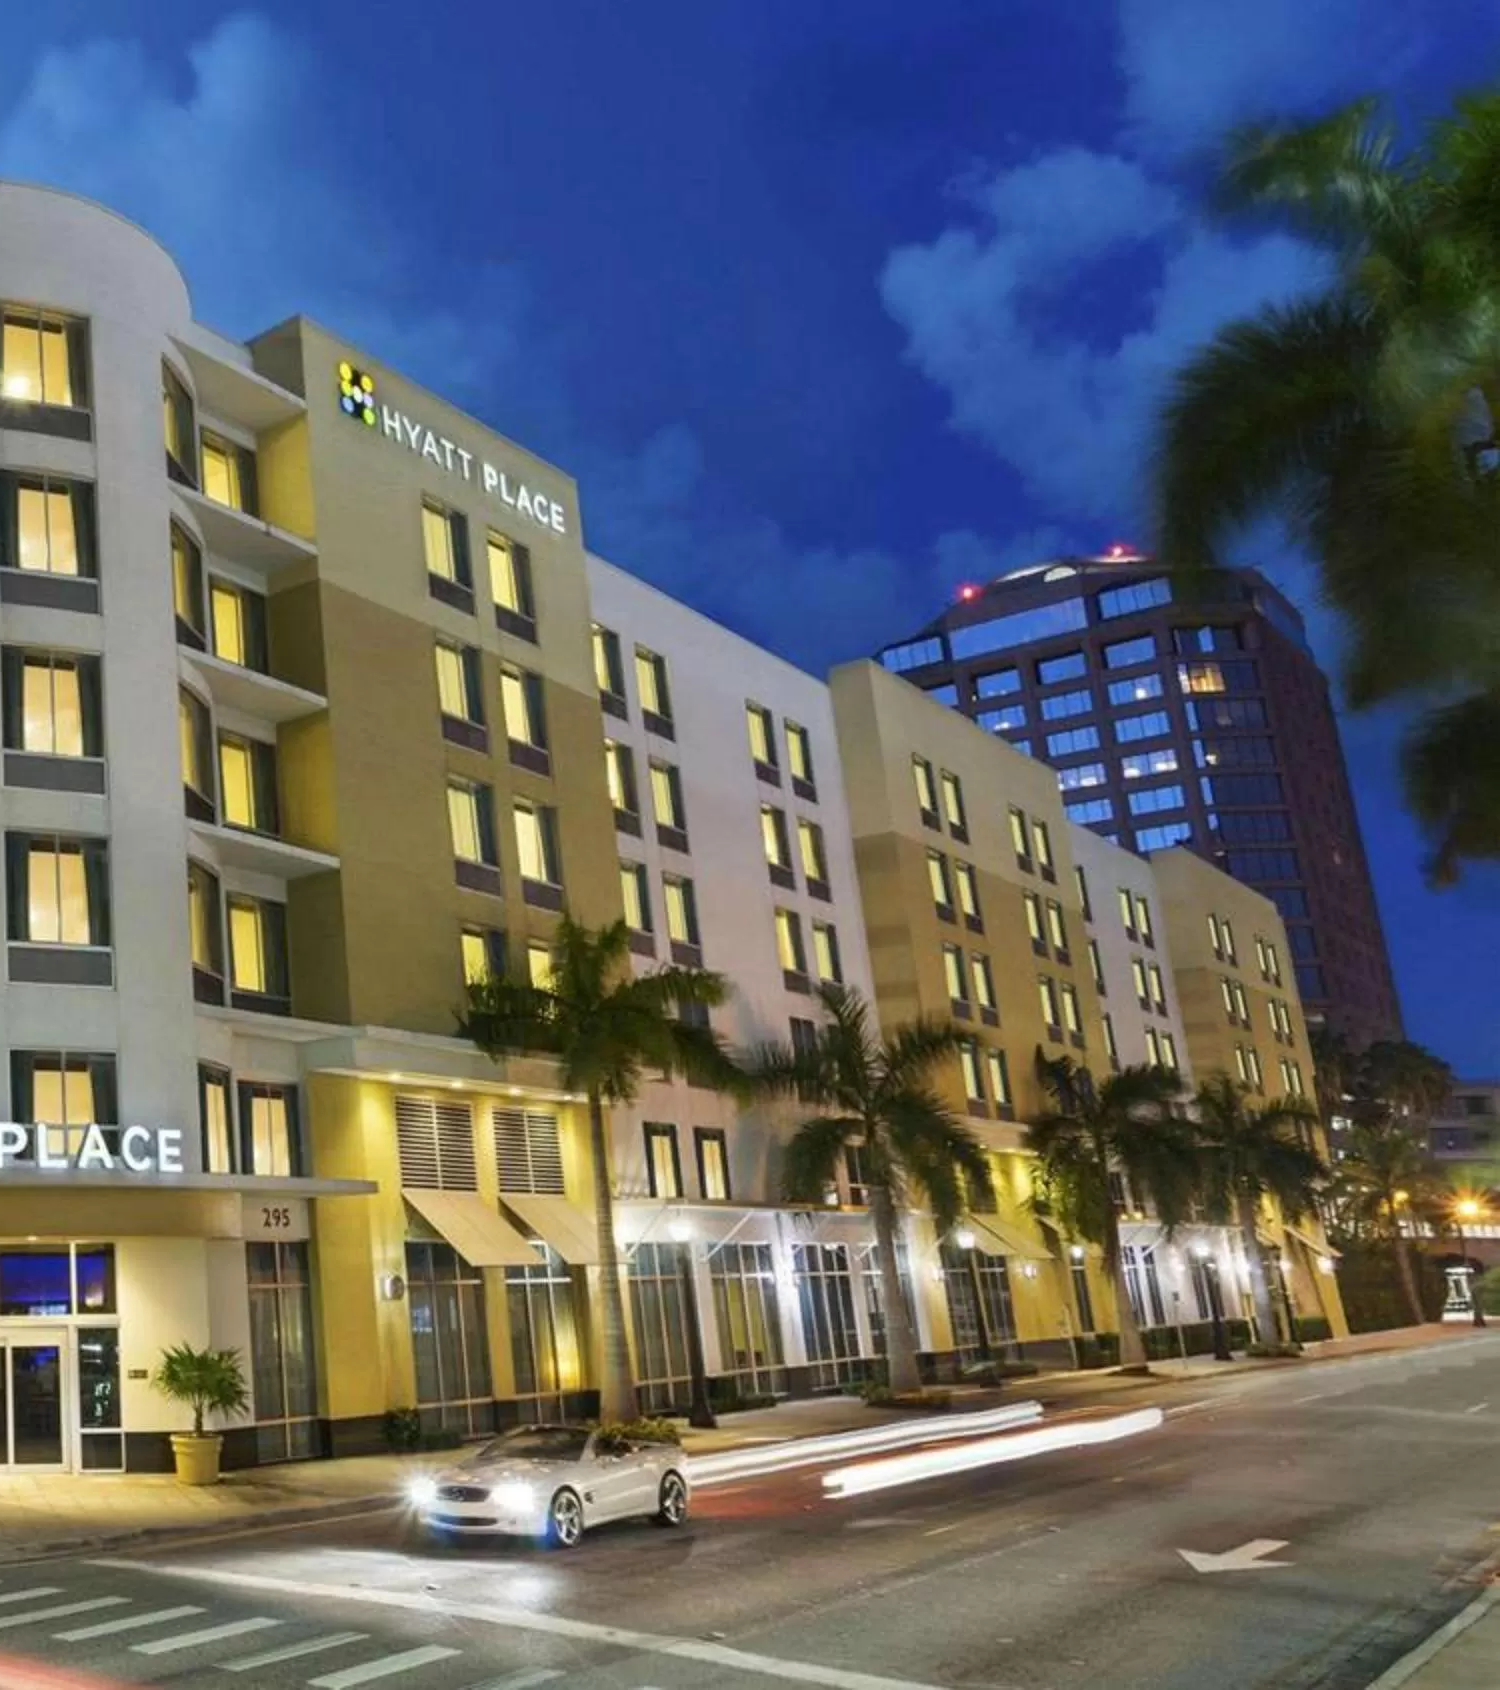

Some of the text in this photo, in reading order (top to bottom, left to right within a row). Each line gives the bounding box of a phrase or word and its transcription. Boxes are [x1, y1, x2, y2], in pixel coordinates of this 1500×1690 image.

[382, 404, 565, 533] HYATT PLACE
[262, 1207, 291, 1229] 295
